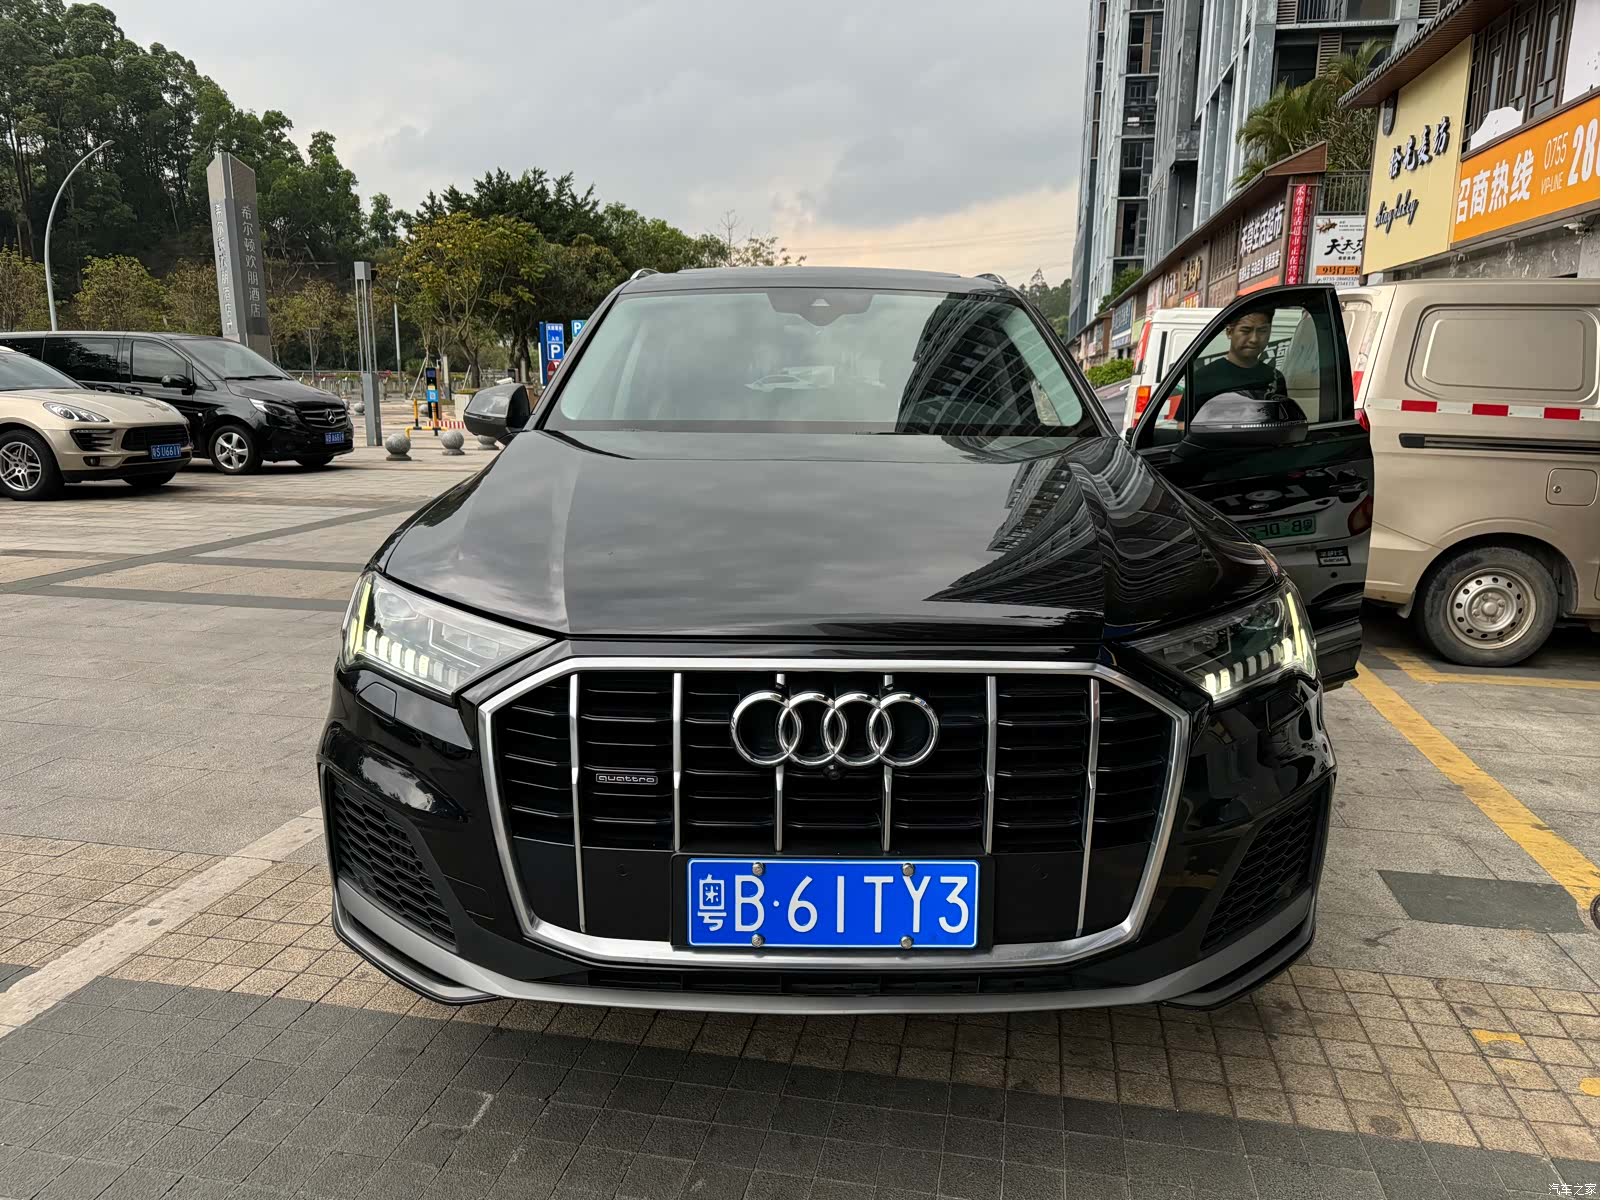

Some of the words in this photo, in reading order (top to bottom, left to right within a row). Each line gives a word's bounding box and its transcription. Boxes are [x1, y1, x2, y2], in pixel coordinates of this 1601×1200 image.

[1544, 131, 1569, 171] 0755
[1567, 117, 1600, 187] 28
[241, 205, 261, 318] 希尔顿欢朋酒店
[574, 322, 581, 334] P
[551, 344, 560, 358] P
[597, 774, 657, 784] quattro
